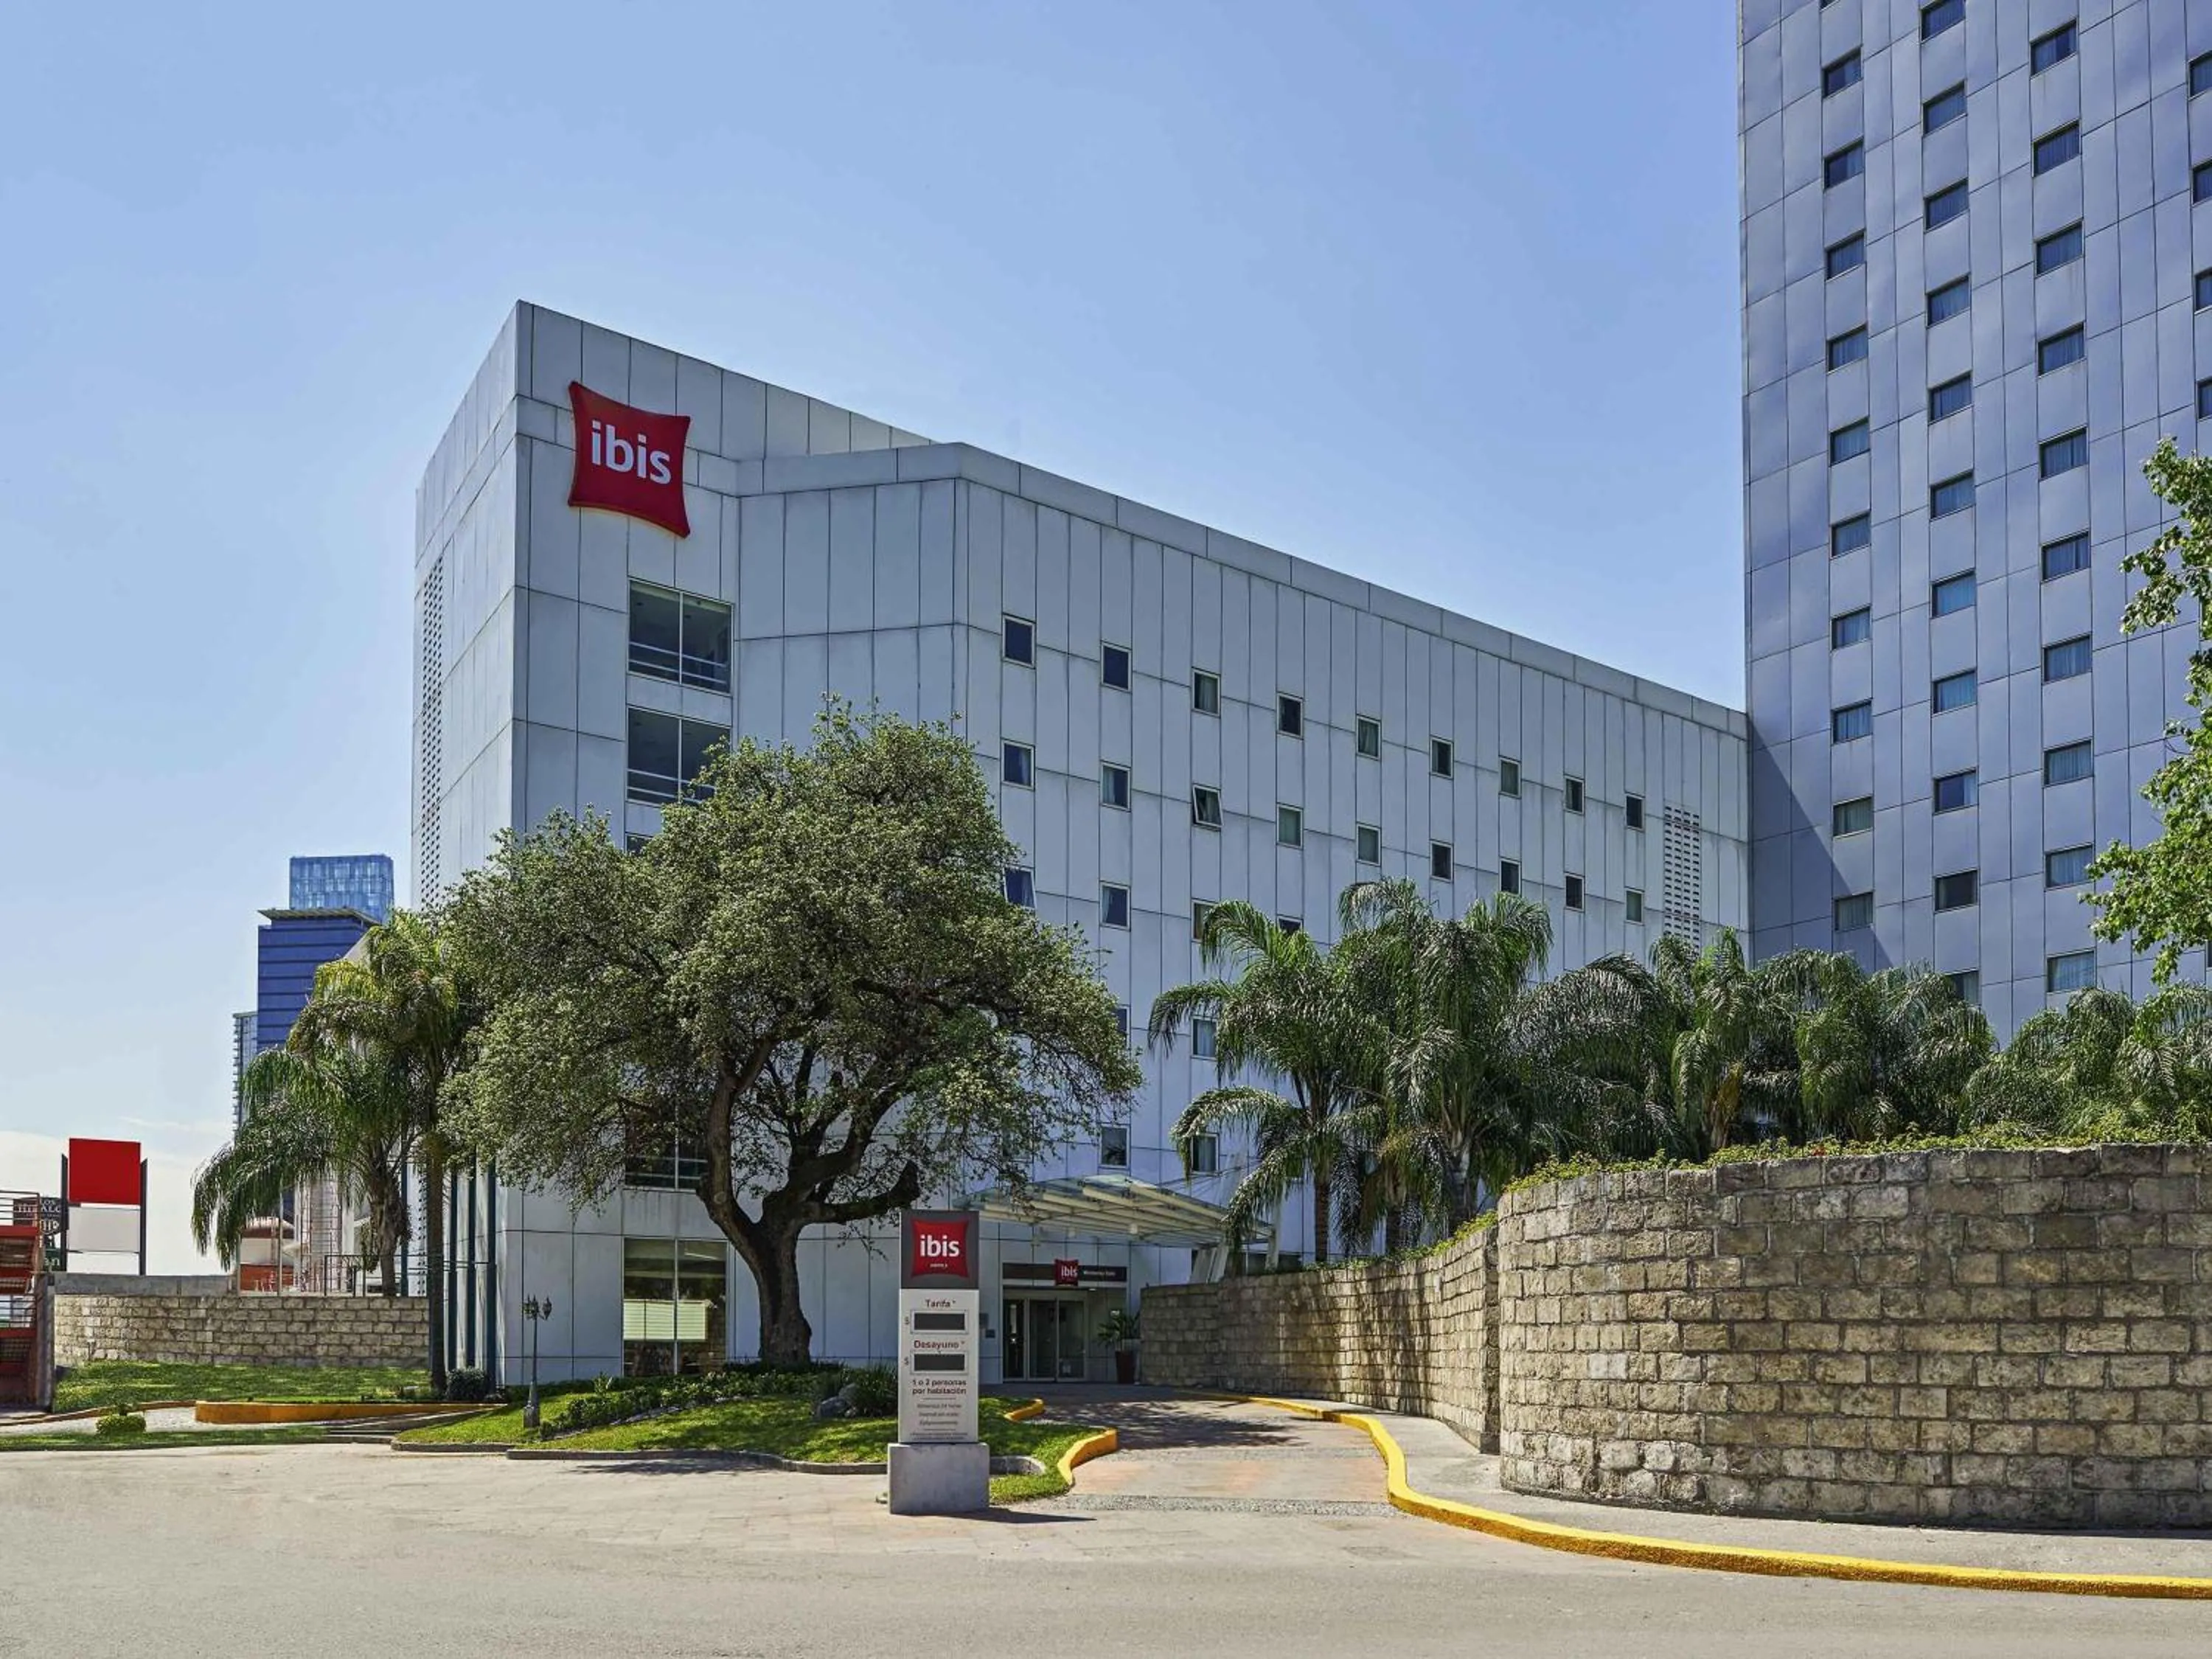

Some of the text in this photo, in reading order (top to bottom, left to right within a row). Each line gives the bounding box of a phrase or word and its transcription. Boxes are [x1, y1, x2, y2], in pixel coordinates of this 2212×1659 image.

[591, 419, 672, 484] ibis
[919, 1234, 960, 1257] ibis
[1061, 1265, 1078, 1277] ibis
[912, 1388, 925, 1396] por
